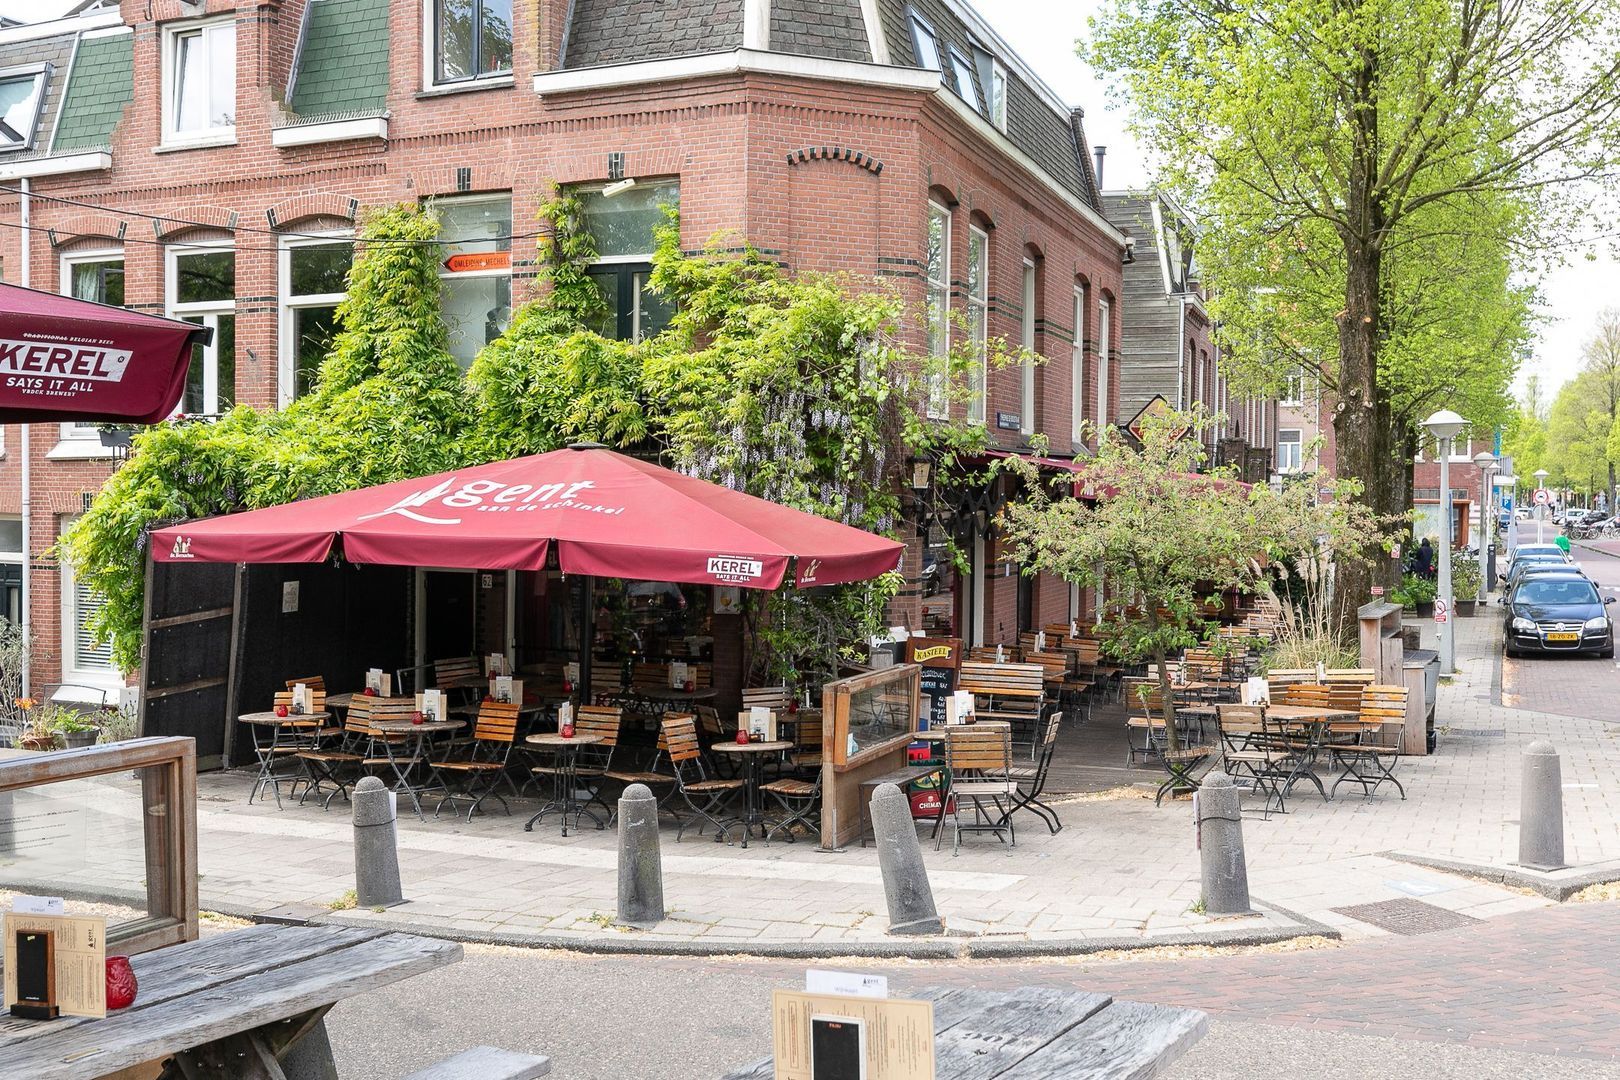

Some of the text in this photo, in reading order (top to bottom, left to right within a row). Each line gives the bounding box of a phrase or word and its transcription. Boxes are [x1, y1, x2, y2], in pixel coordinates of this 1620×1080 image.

[0, 344, 110, 378] KEREL
[6, 377, 94, 392] SAYS IT ALL
[516, 502, 535, 512] de
[711, 560, 755, 575] KEREL
[916, 646, 947, 660] KASTEEL
